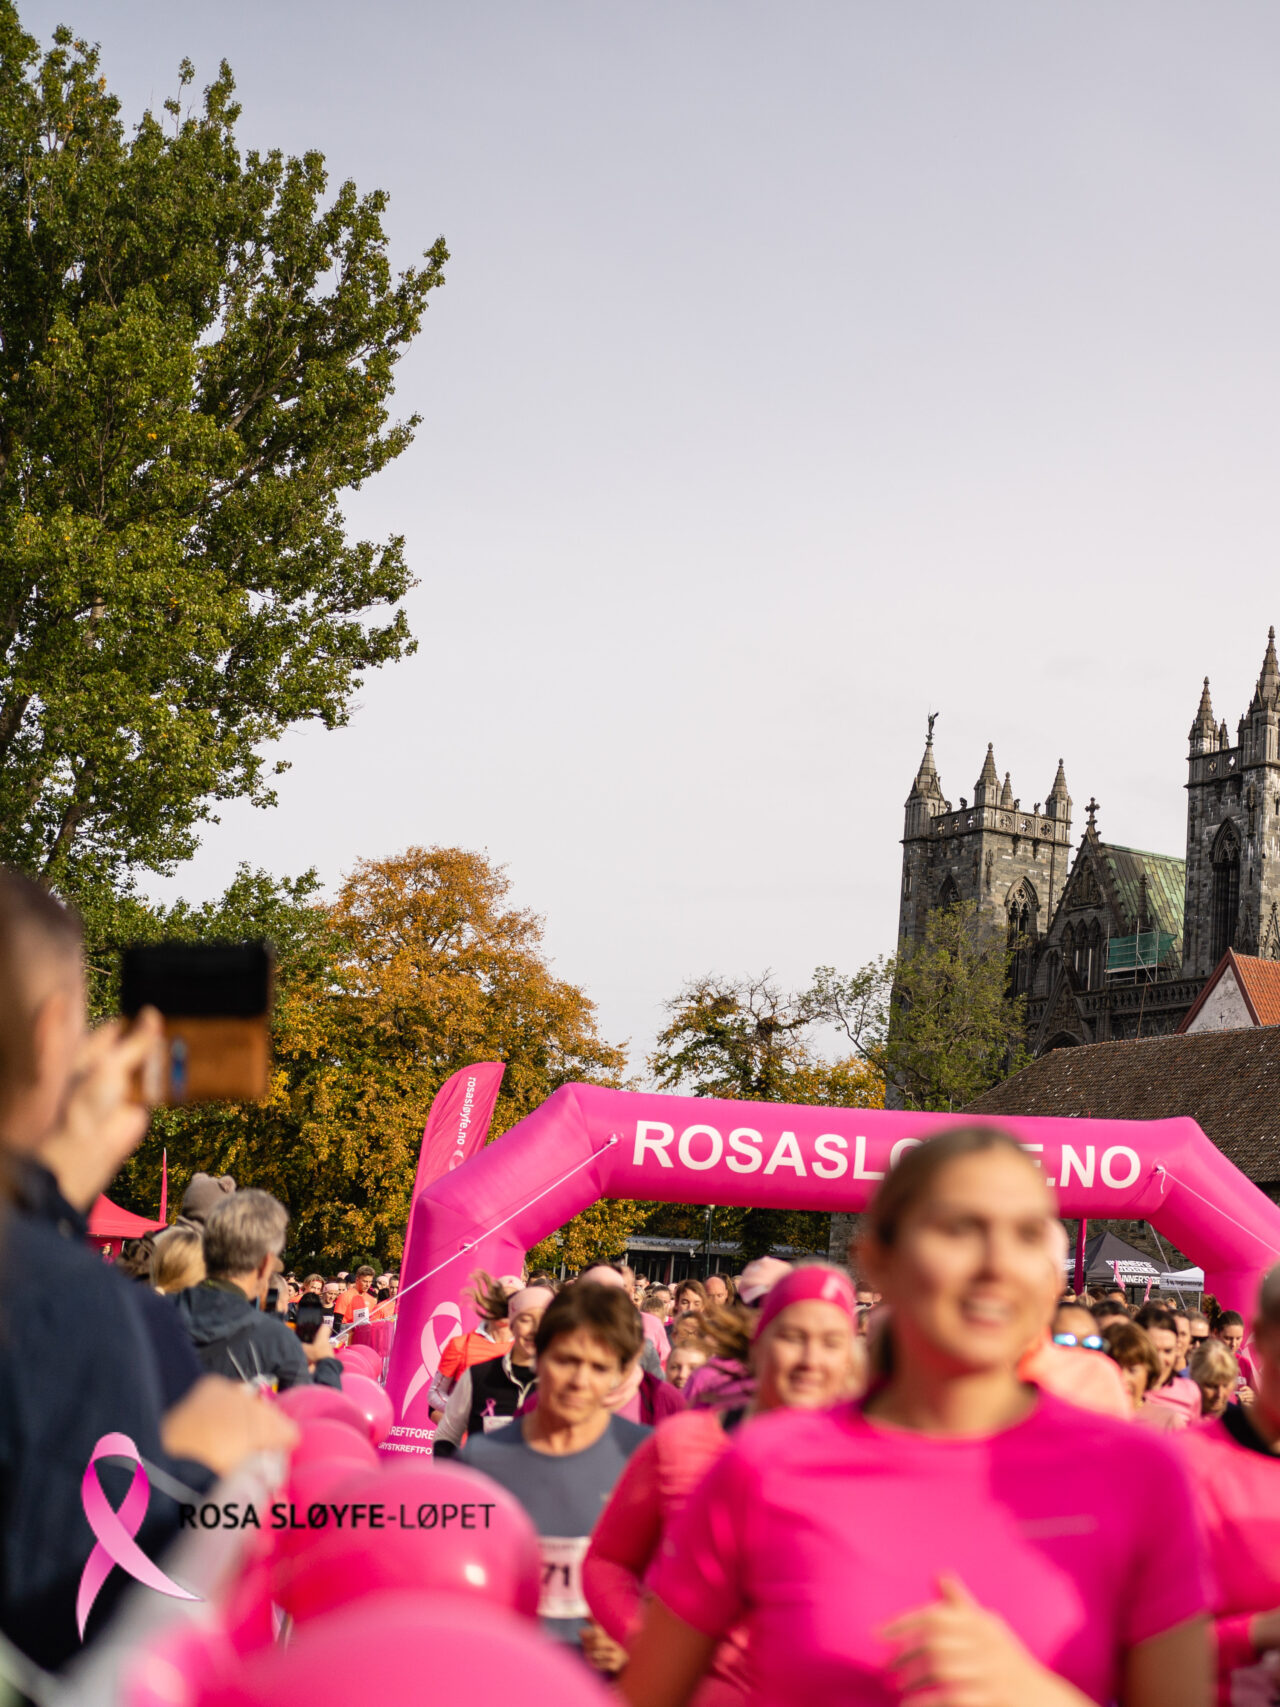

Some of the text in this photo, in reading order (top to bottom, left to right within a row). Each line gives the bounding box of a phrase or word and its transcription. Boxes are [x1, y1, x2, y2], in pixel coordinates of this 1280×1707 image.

[457, 1076, 477, 1146] rosasløyfe.no
[632, 1119, 1141, 1190] ROSASL.NO
[389, 1426, 435, 1440] REFTFORE
